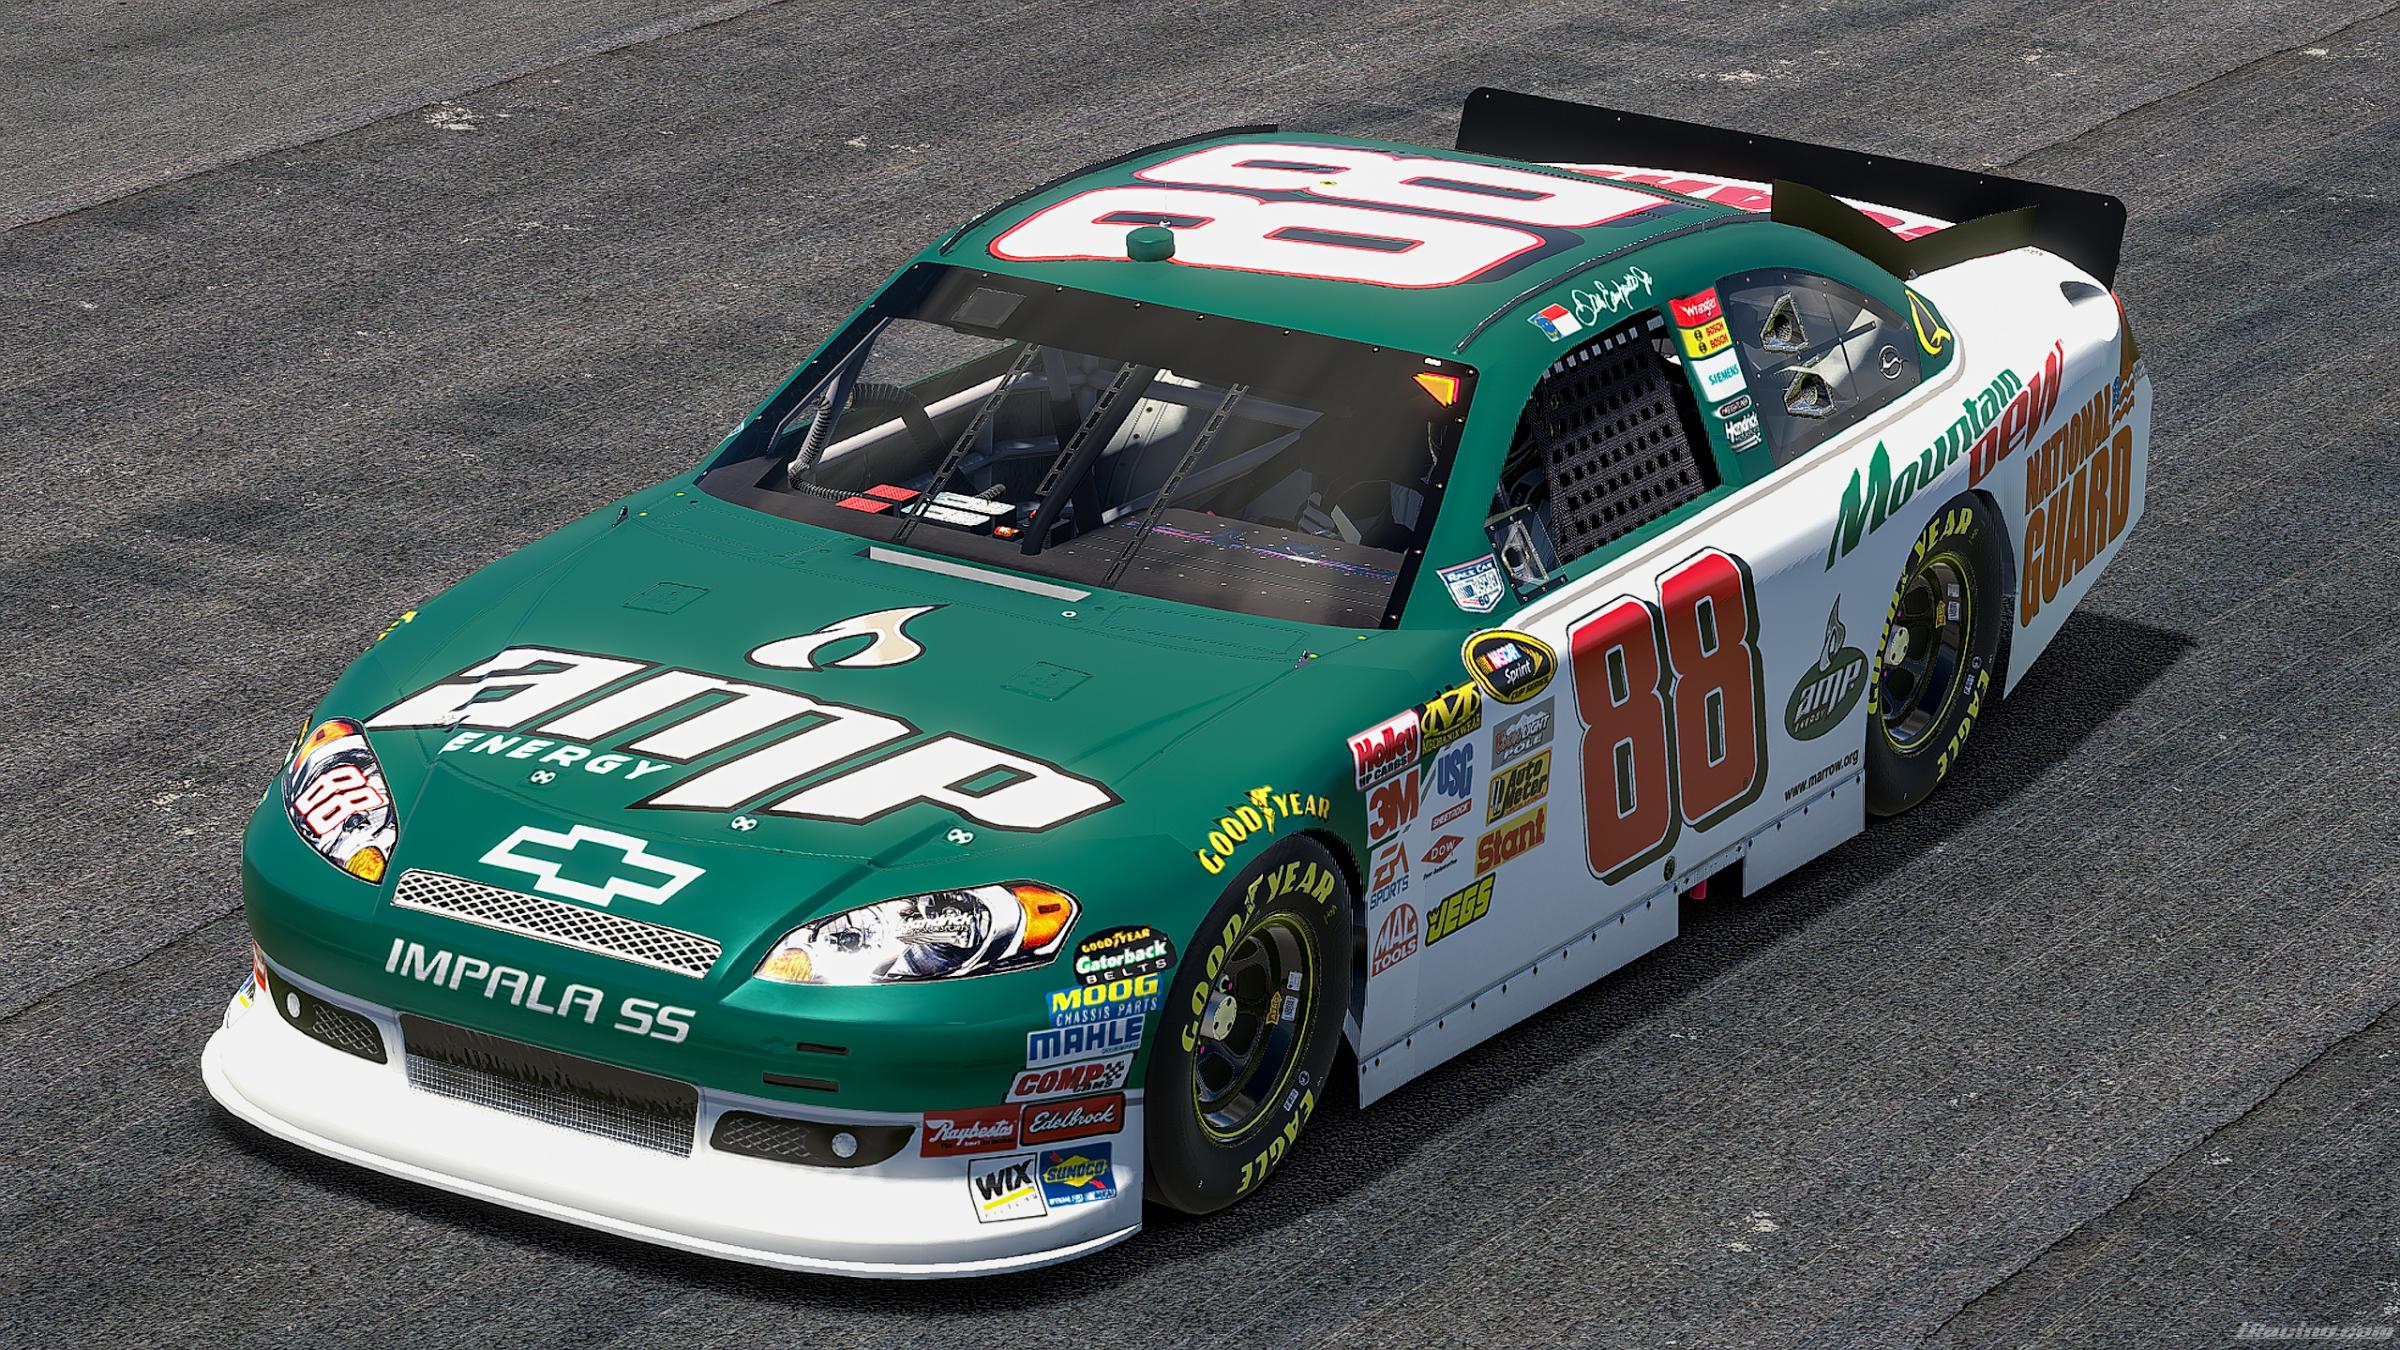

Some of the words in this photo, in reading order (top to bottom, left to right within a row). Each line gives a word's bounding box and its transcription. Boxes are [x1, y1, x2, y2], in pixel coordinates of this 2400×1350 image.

[1680, 297, 1717, 317] Wrangler
[1706, 321, 1725, 337] BOSCH
[1710, 333, 1729, 350] BOSCH
[1708, 365, 1740, 386] SIEMENS
[1824, 368, 2023, 573] Mountain
[2025, 383, 2112, 516] NATIONAL
[2020, 424, 2133, 628] GUARD
[1504, 659, 1532, 685] Sprint
[1521, 714, 1550, 741] LIGHT
[1567, 546, 1766, 883] 88
[1936, 668, 1990, 783] EAGLE
[440, 732, 671, 780] ENERGY
[1354, 725, 1417, 777] Holley
[1437, 743, 1474, 799] USG
[1784, 749, 1860, 802] www.marrow.org
[295, 763, 386, 837] 88
[1369, 768, 1419, 841] 3M
[1431, 839, 1456, 860] DOW
[1477, 808, 1545, 876] Stant
[1369, 873, 1410, 912] SPORTS
[1427, 876, 1494, 945] JEGS
[1375, 904, 1417, 959] MAC
[1075, 940, 1168, 975] Gatorback
[1086, 958, 1168, 985] BELTS
[1373, 938, 1418, 974] TOOLS
[385, 938, 605, 1024] IMPALA
[614, 996, 696, 1043] SS
[1052, 972, 1160, 1013] MOOG
[1056, 1007, 1110, 1028] CHASSIS
[1116, 997, 1158, 1017] PARTS
[1029, 1016, 1144, 1061] MAHLE
[1014, 1063, 1105, 1096] COMP
[926, 1119, 1014, 1146] Raybestos
[1029, 1104, 1116, 1134] Edelbrock
[1236, 1088, 1314, 1194] EAGLE
[975, 1159, 1034, 1201] WIX
[1046, 1160, 1107, 1182] SUNOCO
